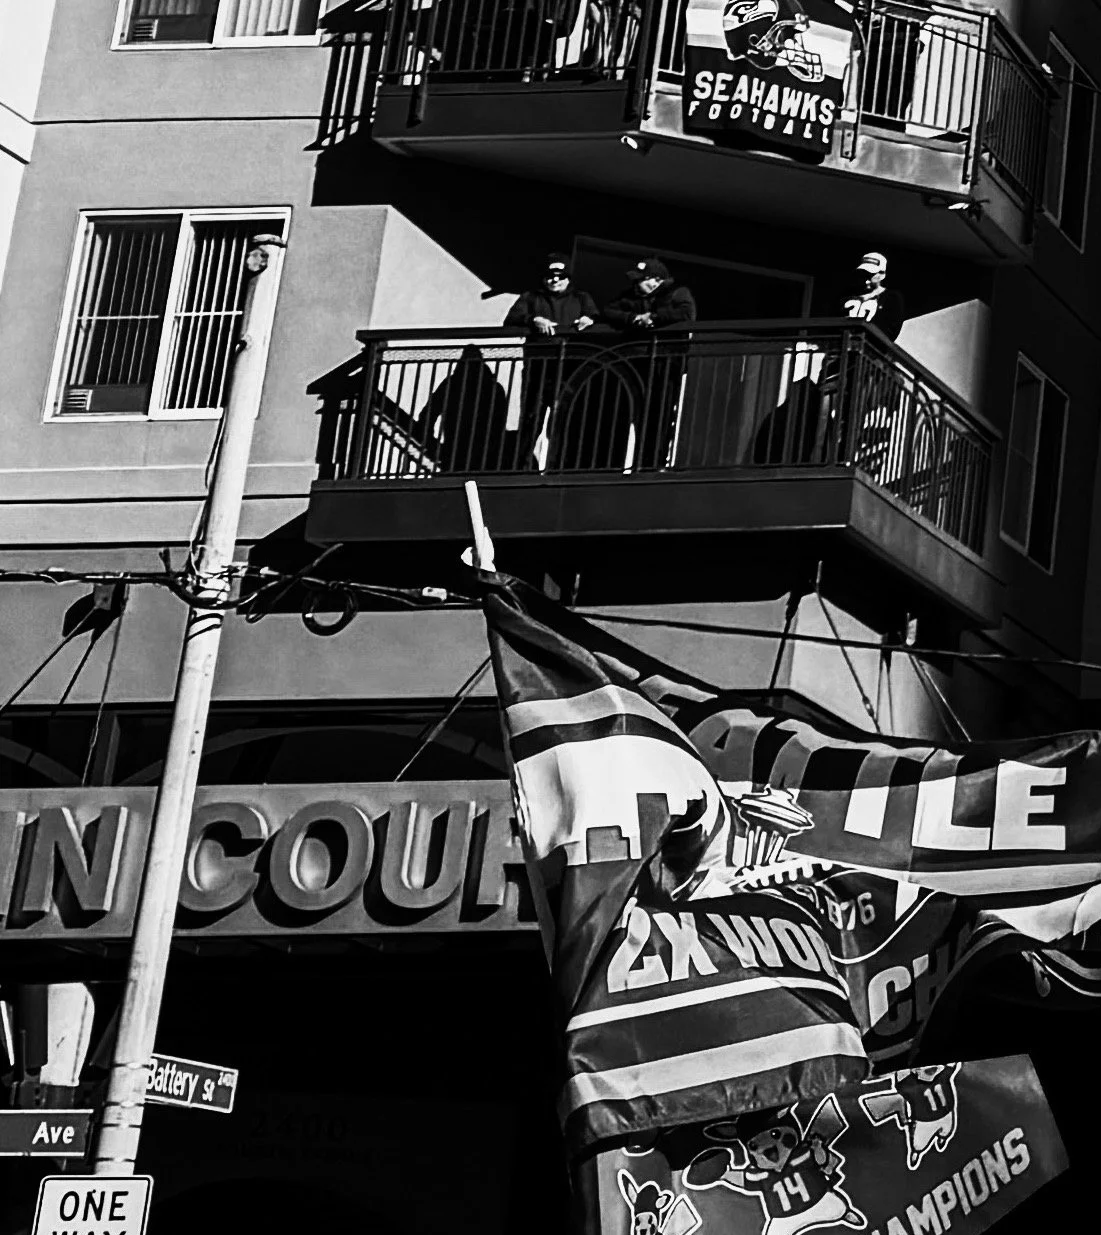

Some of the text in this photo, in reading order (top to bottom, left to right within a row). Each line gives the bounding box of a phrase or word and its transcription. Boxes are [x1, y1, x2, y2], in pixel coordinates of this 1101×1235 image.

[693, 70, 835, 126] SEAHAWKS
[687, 100, 830, 144] FOOTBALL
[31, 1120, 75, 1145] Ave
[59, 1190, 129, 1221] ONE
[772, 1171, 810, 1212] 14
